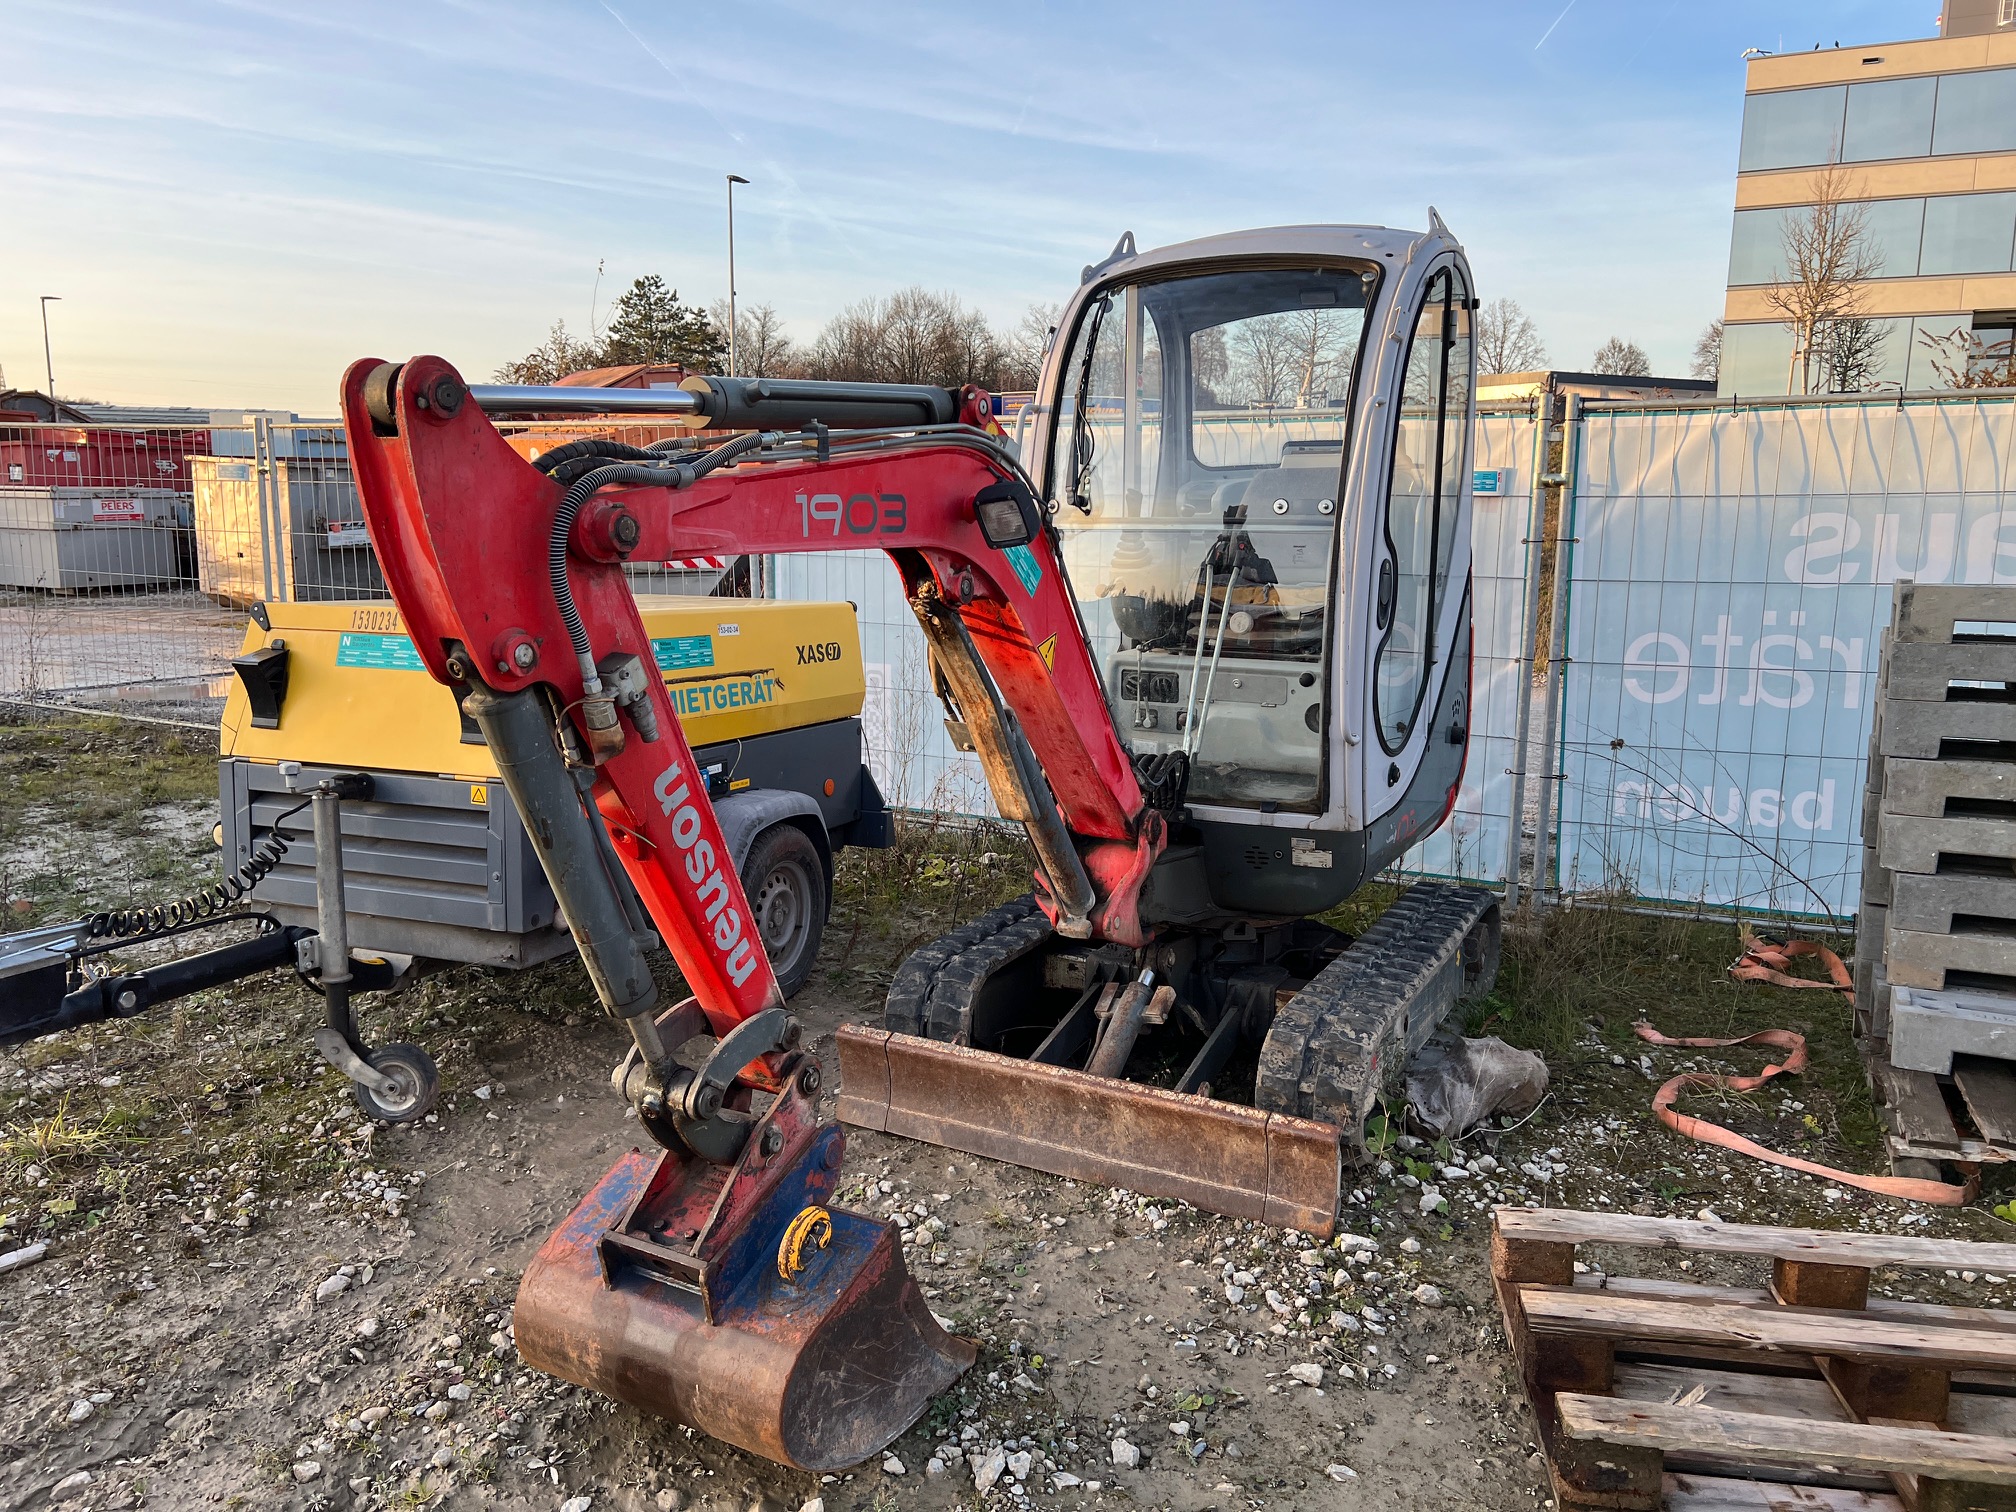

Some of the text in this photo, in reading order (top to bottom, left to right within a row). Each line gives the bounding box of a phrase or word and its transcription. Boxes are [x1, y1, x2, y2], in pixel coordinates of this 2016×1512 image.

[101, 500, 135, 511] PETERS
[795, 494, 907, 537] 1903
[352, 610, 399, 631] 1530234
[342, 636, 351, 646] N
[653, 642, 660, 652] N
[796, 643, 825, 665] XAS
[653, 760, 757, 988] neuson
